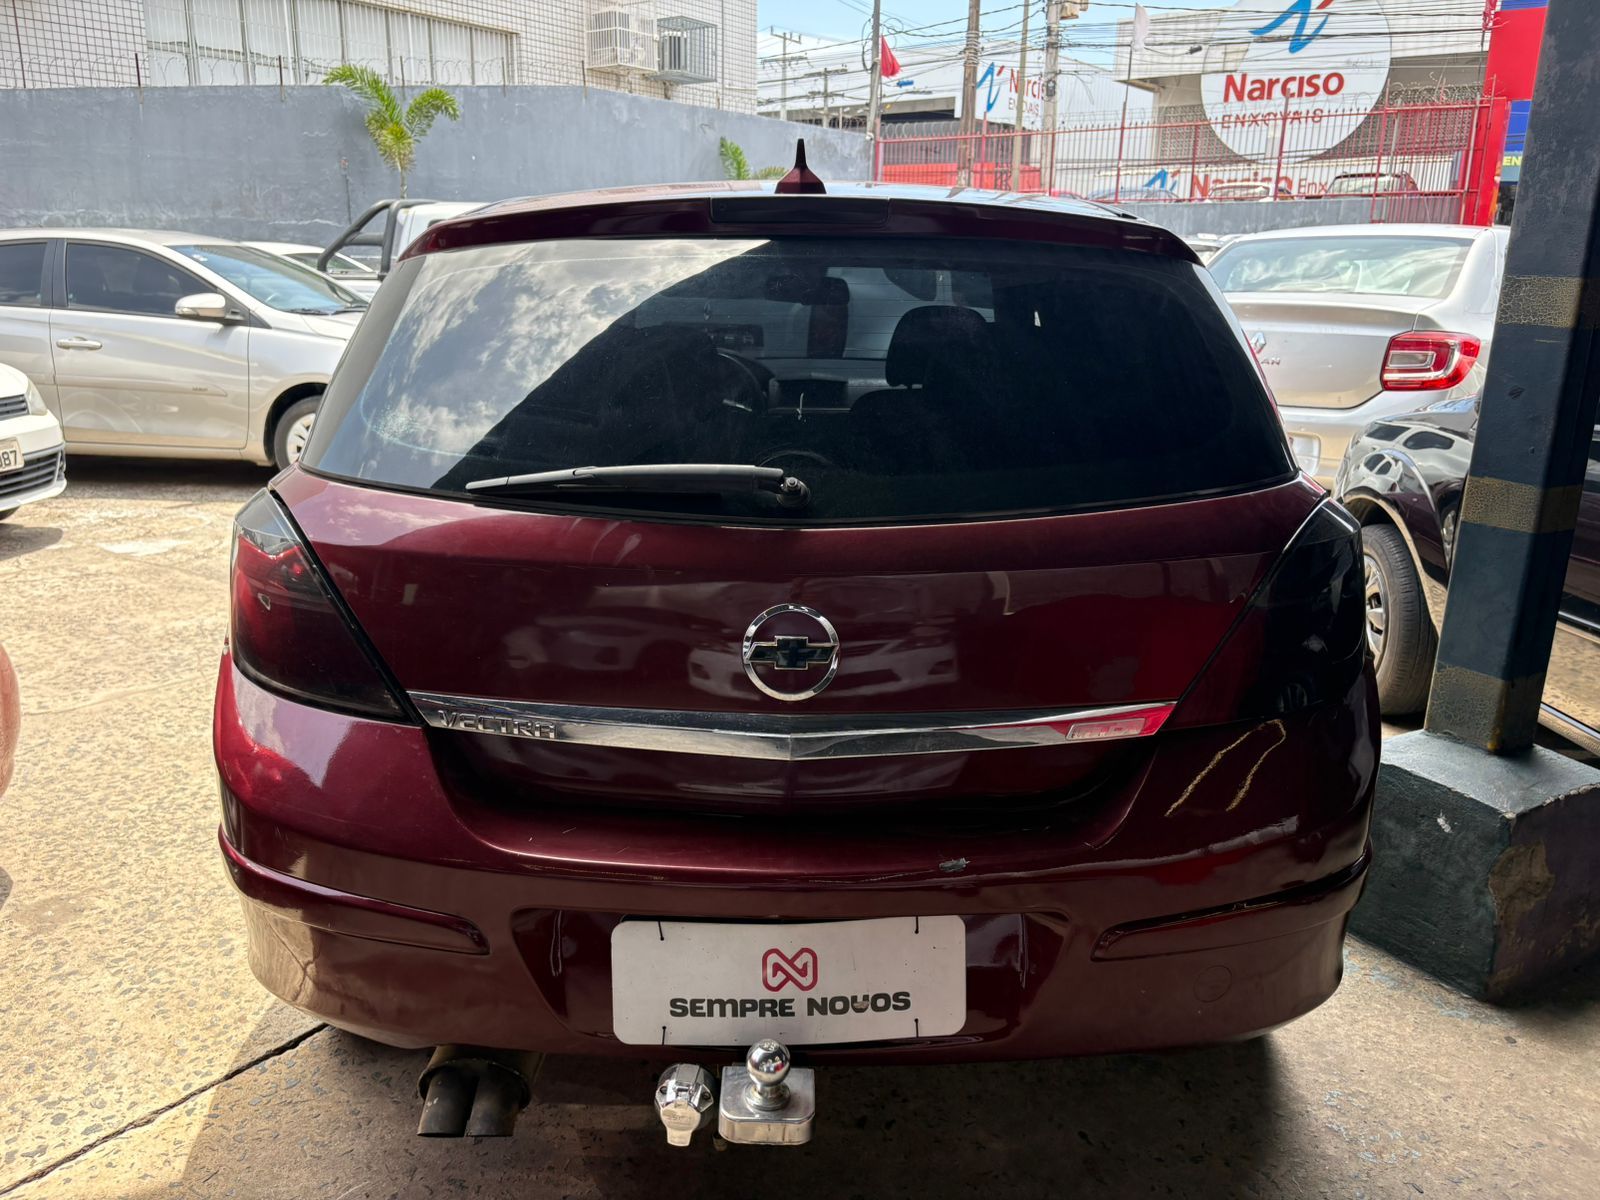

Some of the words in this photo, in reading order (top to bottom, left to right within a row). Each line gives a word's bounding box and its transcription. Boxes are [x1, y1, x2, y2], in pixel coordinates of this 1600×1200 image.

[1223, 72, 1345, 104] Narciso
[438, 710, 556, 739] VECTRA
[669, 997, 796, 1019] SEMPRE
